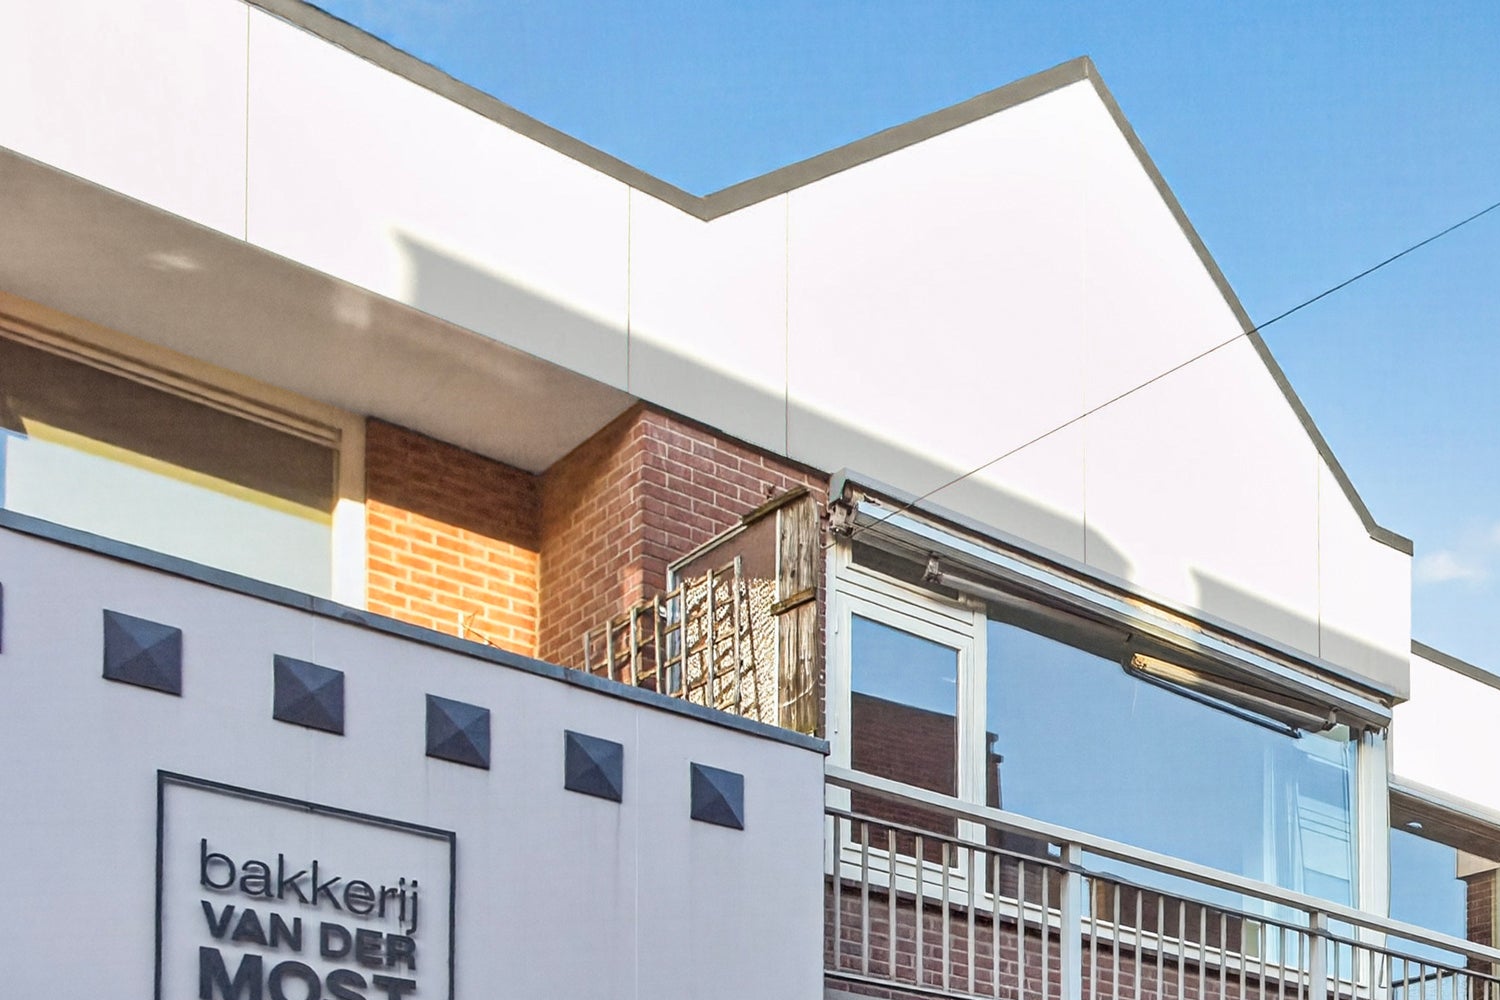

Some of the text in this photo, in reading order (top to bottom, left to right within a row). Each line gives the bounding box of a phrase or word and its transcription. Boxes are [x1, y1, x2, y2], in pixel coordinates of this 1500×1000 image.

[200, 838, 418, 936] bakkerij
[201, 900, 416, 970] VAN DER
